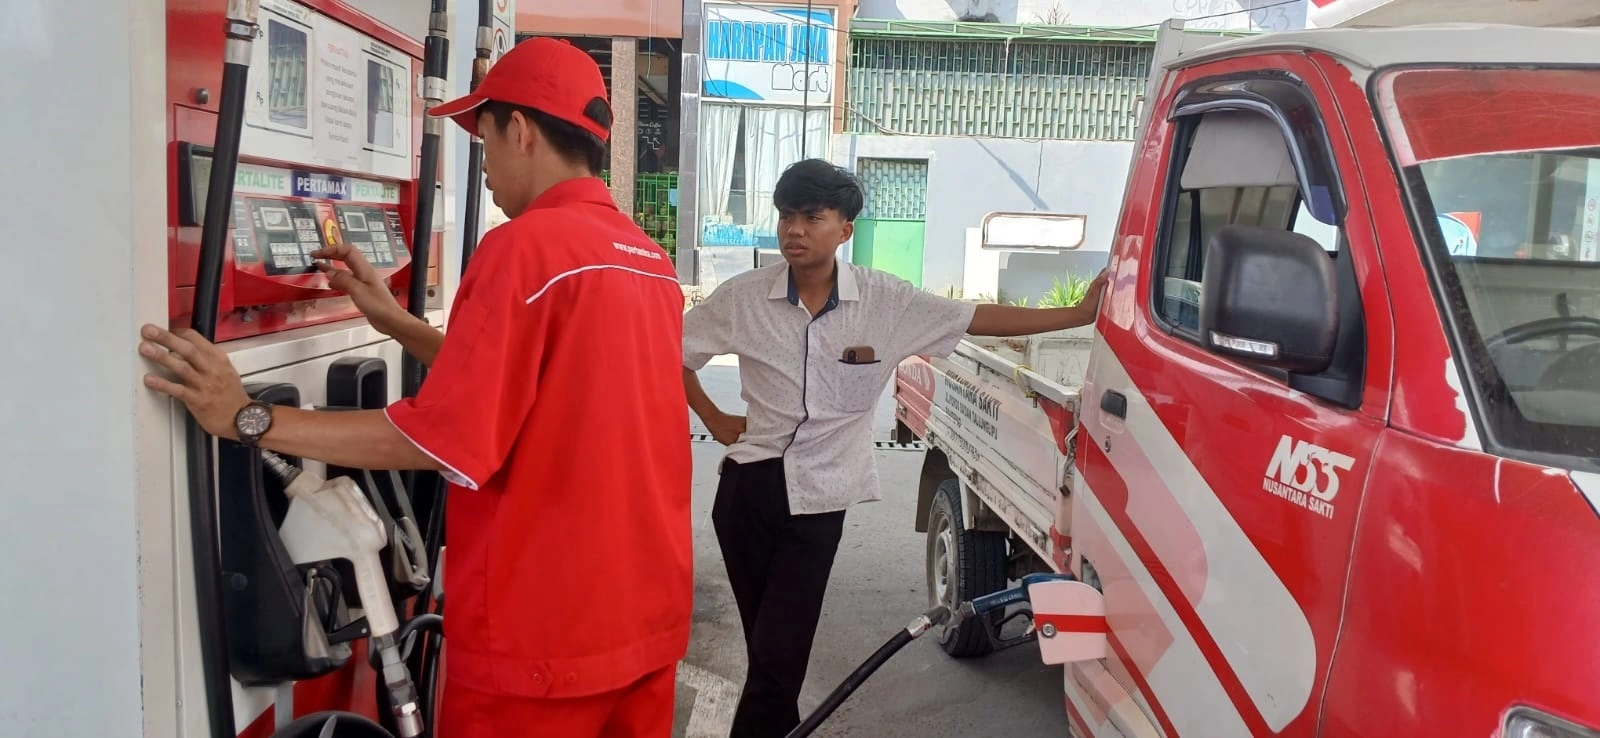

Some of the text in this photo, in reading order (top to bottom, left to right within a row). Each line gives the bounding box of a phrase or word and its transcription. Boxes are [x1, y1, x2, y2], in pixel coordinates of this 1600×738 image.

[707, 20, 830, 65] HARAPAN JAYA
[772, 63, 828, 92] Mart
[297, 176, 347, 196] PERTAMAX
[355, 184, 396, 199] PERTALITE
[979, 391, 1002, 421] SAKTI
[1262, 477, 1334, 520] NUSANTARA SAKTI
